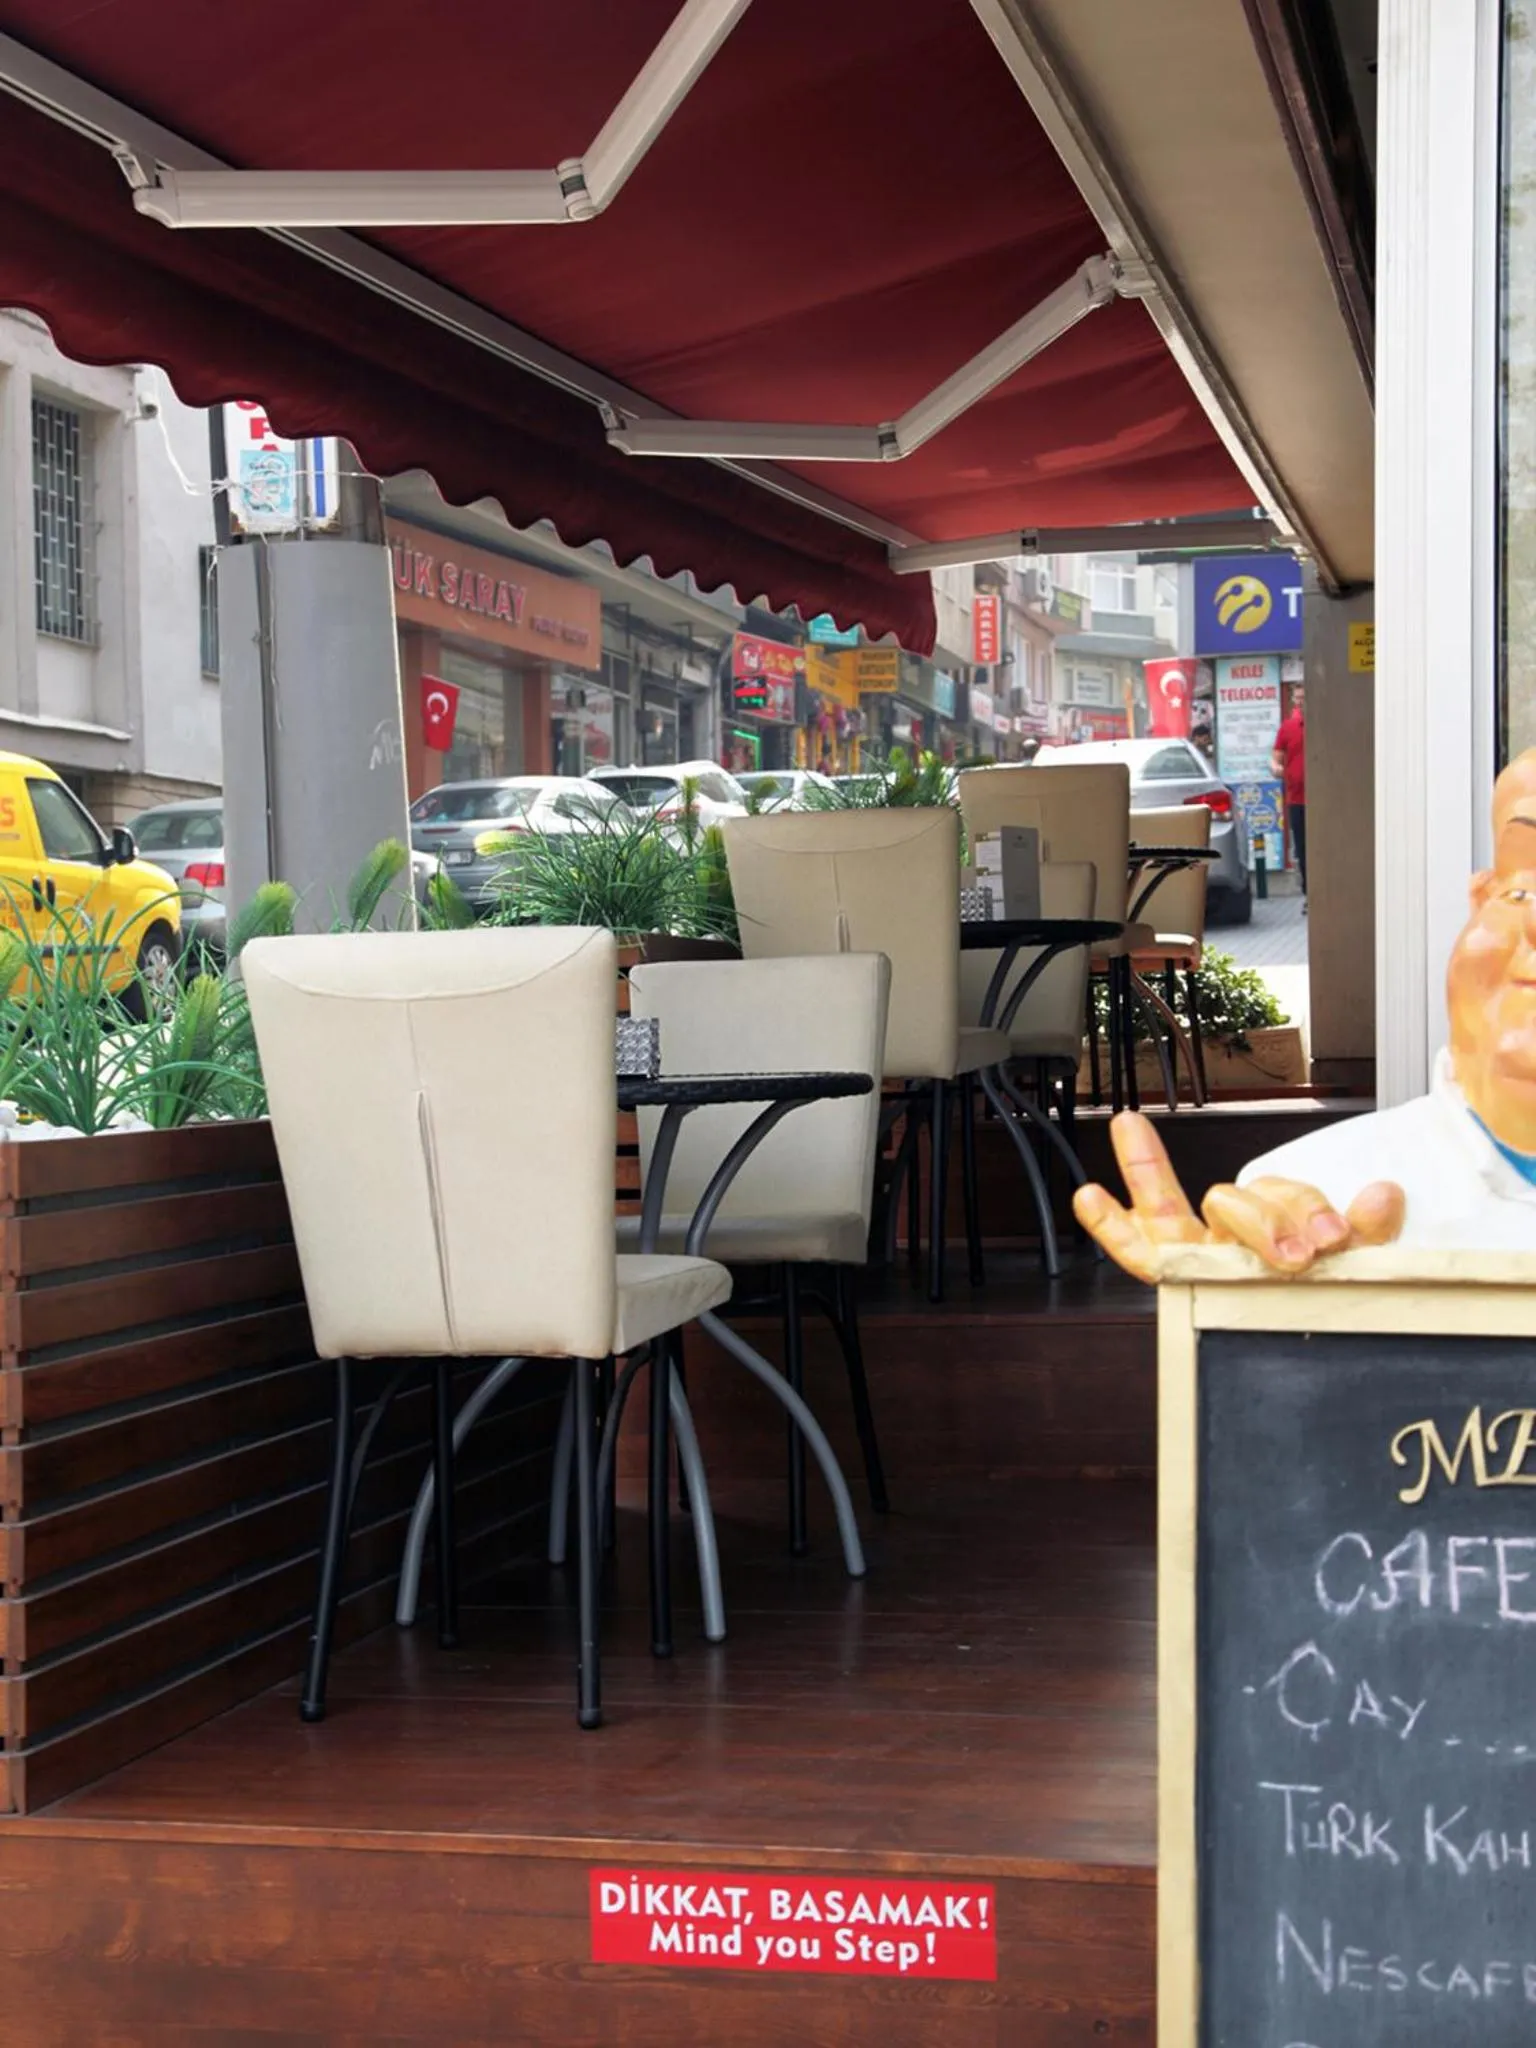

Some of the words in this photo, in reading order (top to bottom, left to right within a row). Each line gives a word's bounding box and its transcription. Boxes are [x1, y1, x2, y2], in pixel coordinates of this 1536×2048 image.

[440, 561, 527, 624] SARAY
[1219, 685, 1277, 703] TELEKOM
[1314, 1529, 1536, 1622] CAFE
[599, 1874, 755, 1925] DİKKAT,
[769, 1889, 989, 1931] BASAMAK!
[648, 1920, 743, 1956] Mind
[754, 1935, 821, 1966] you
[834, 1928, 937, 1971] Step!
